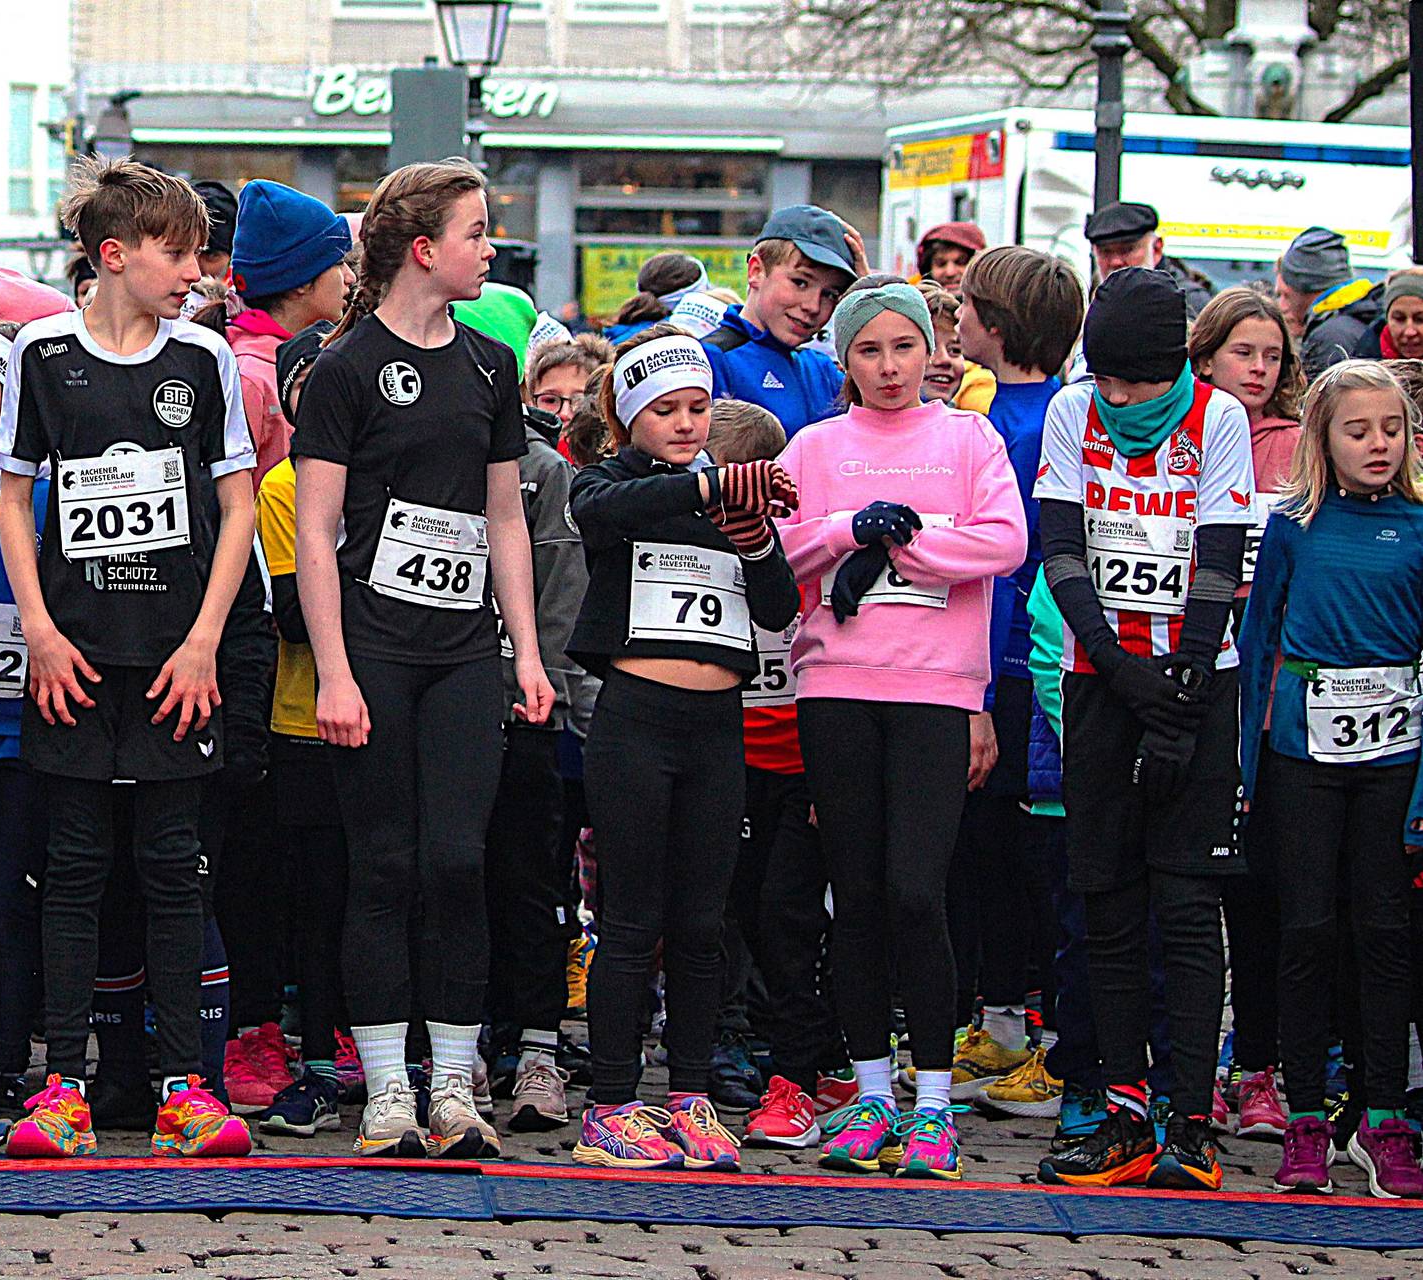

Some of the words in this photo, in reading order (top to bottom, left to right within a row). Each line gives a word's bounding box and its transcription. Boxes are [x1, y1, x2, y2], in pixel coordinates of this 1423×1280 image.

[39, 342, 69, 360] Julian
[646, 348, 698, 364] AACHENER
[624, 361, 647, 386] 47
[163, 387, 189, 405] BTB
[161, 404, 189, 416] AACHEN
[1083, 440, 1114, 455] erima
[80, 466, 118, 477] AACHENER
[80, 471, 135, 483] SILVESTERLAUF
[839, 460, 955, 481] Champion
[1085, 481, 1197, 519] REWE
[69, 496, 176, 542] 2031
[412, 515, 450, 528] AACHENER
[1097, 520, 1133, 530] AACHENER
[411, 521, 461, 536] SILVESTERLAUF
[1097, 526, 1148, 538] SILVESTERLAUF
[659, 553, 698, 562] AACHENER
[659, 560, 711, 571] SILVESTERLAUF
[396, 553, 472, 594] 438
[1091, 556, 1183, 599] 1254
[108, 583, 168, 592] STEUERBERATER
[671, 590, 723, 627] 79
[1332, 678, 1371, 686] AACHENER
[1332, 683, 1386, 692] SILVESTERLAUF
[1332, 706, 1411, 748] 312
